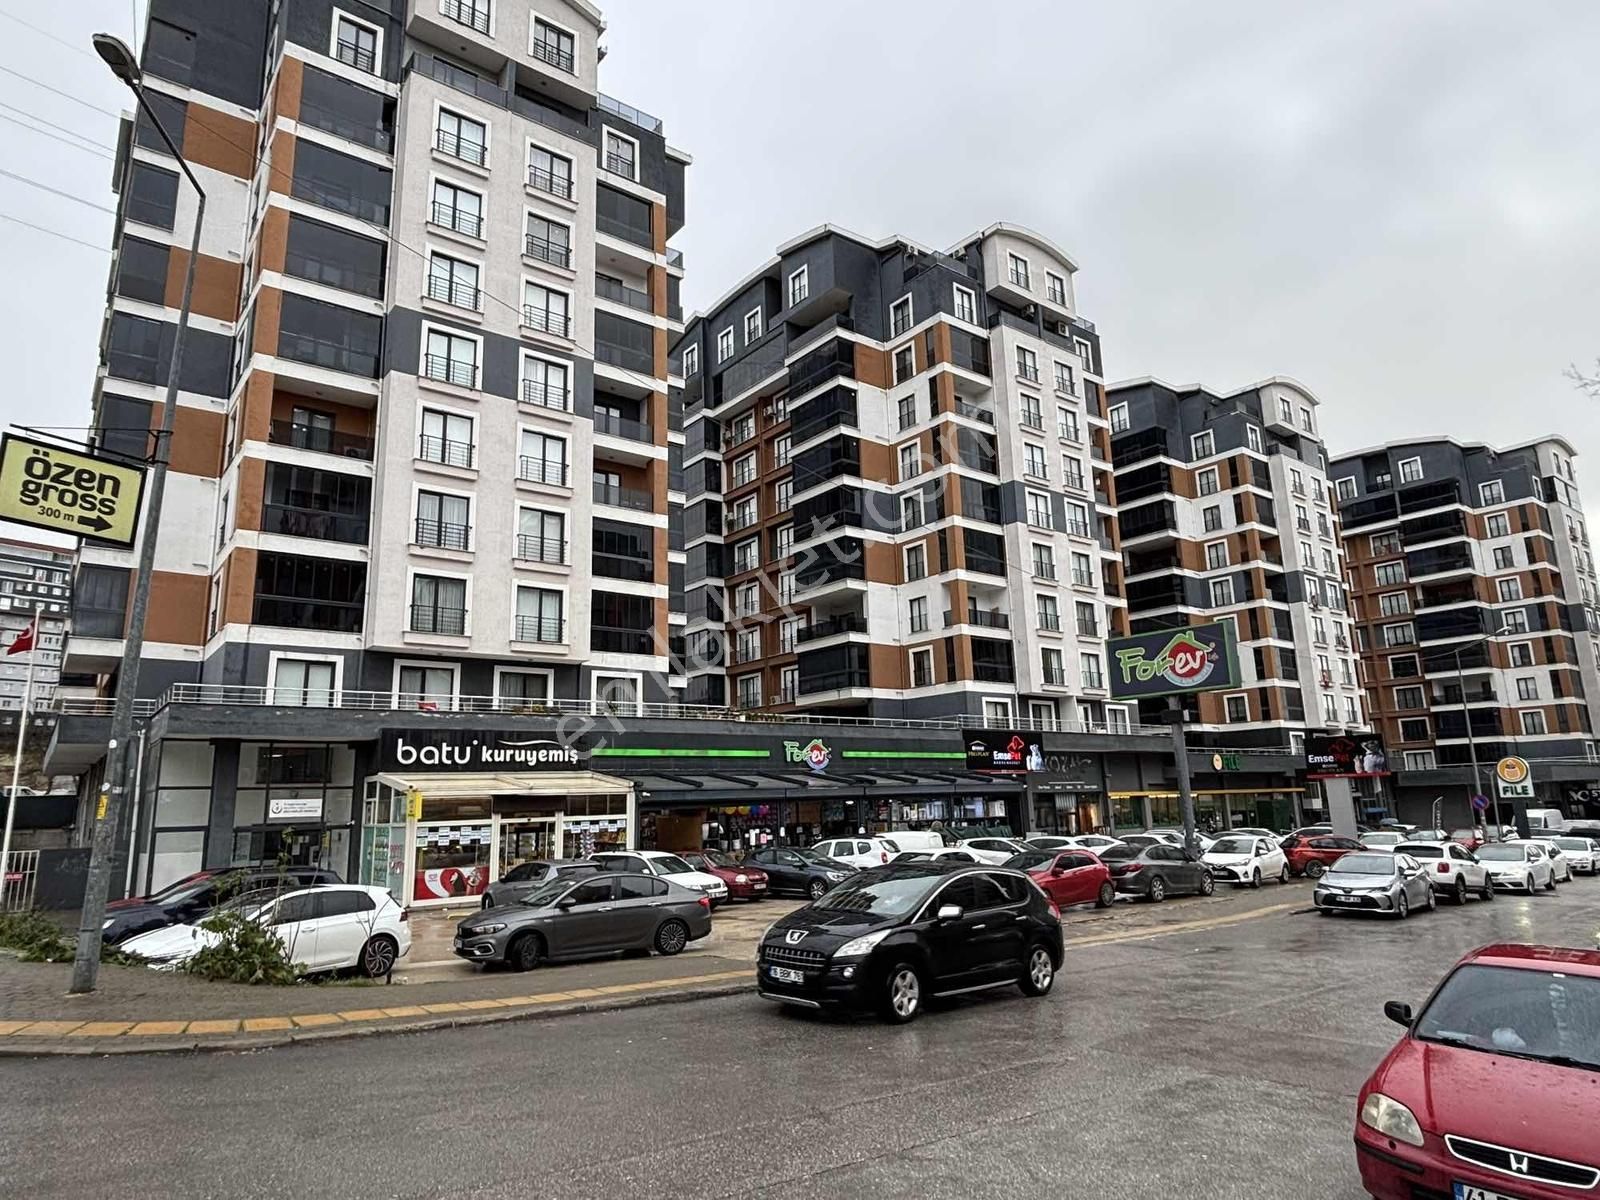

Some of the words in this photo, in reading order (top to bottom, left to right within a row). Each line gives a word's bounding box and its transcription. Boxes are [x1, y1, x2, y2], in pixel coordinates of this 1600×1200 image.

[24, 448, 121, 498] özen
[19, 479, 116, 516] gross
[37, 505, 61, 519] 300
[63, 512, 75, 522] m
[397, 738, 471, 765] batu
[481, 745, 578, 766] kuruyemiş
[1502, 785, 1530, 796] FILE
